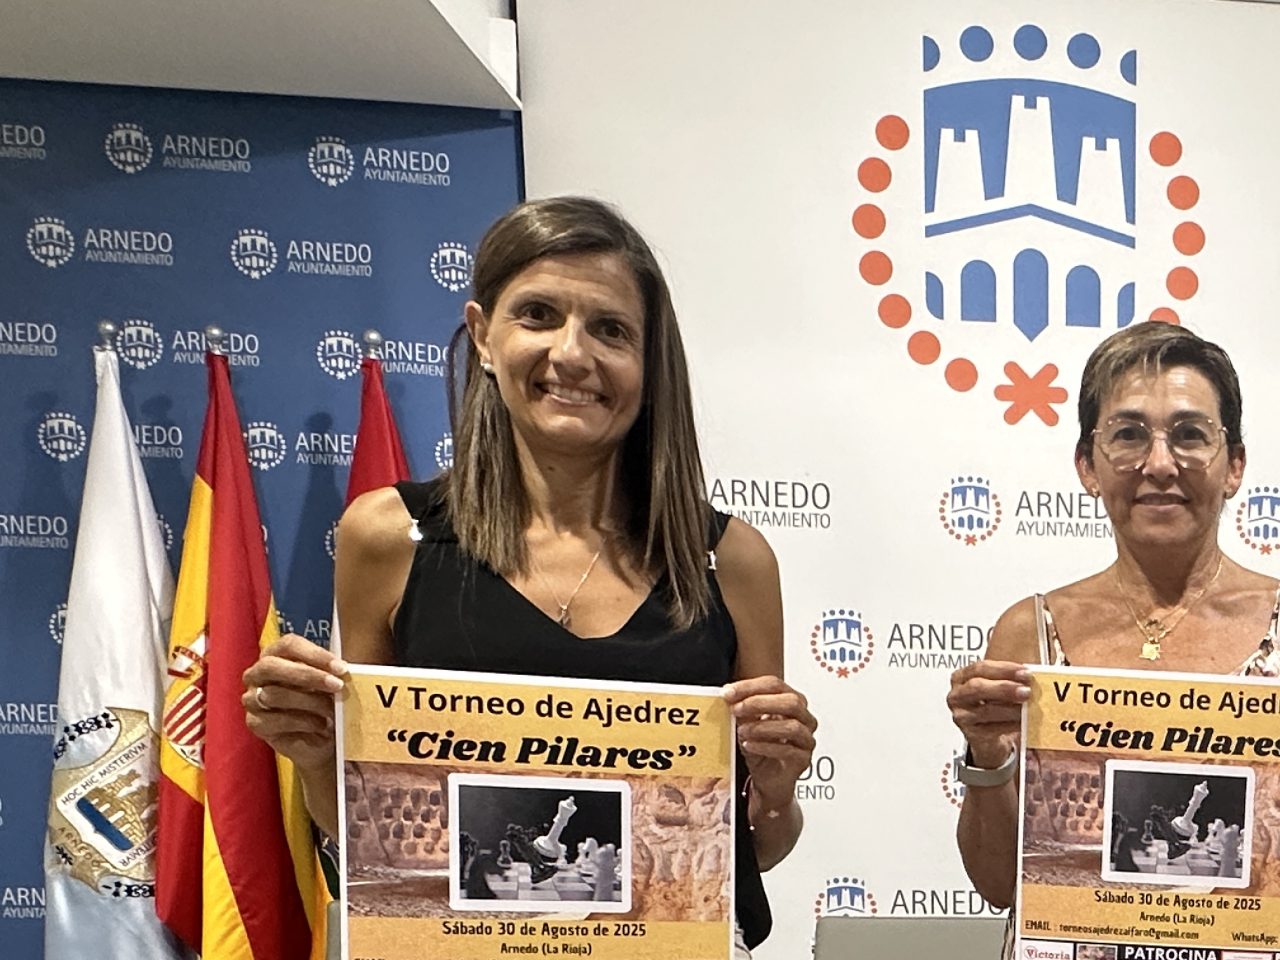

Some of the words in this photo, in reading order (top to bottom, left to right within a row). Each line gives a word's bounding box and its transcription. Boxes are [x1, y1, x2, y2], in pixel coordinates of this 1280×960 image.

[0, 124, 46, 147] EDO
[162, 133, 250, 159] ARNEDO
[162, 156, 251, 173] AYUNTAMIENTO
[363, 146, 450, 173] ARNEDO
[364, 168, 450, 187] AYUNTAMIENTO
[84, 228, 173, 253] ARNEDO
[85, 250, 173, 266] AYUNTAMIENTO
[287, 239, 372, 264] ARNEDO
[288, 260, 373, 277] AYUNTAMIENTO
[0, 321, 57, 344] NEDO
[133, 425, 183, 446] NEDO
[295, 432, 356, 454] ARNE
[709, 478, 831, 510] ARNEDO
[1015, 490, 1108, 520] ARNED
[0, 515, 68, 536] RNEDO
[1016, 520, 1114, 539] AYUNTAMIEN
[375, 685, 399, 709] V
[408, 687, 525, 715] Torneo
[536, 694, 574, 719] de
[583, 698, 700, 728] Ajedrez
[1053, 681, 1071, 702] V
[1078, 683, 1171, 709] Torneo
[1180, 688, 1211, 712] de
[1060, 720, 1154, 750] “Cien
[387, 729, 507, 762] “Cien
[515, 736, 697, 771] Pilares”
[61, 788, 84, 805] HOC
[3, 887, 46, 906] ARN
[1095, 890, 1134, 904] Sábado
[1138, 893, 1153, 905] 30
[1156, 895, 1170, 906] de
[1173, 895, 1213, 910] Agosto
[1216, 897, 1230, 909] de
[1233, 898, 1261, 911] 2025
[1139, 911, 1170, 923] Arnedo
[1173, 913, 1187, 924] (La
[1189, 915, 1215, 926] Rioja)
[442, 920, 492, 935] Sábado
[497, 922, 515, 936] 30
[520, 922, 536, 936] de
[541, 923, 589, 939] Agosto
[593, 923, 609, 936] de
[613, 923, 646, 937] 2025
[500, 943, 539, 954] Arnedo
[542, 942, 558, 956] (La
[561, 943, 592, 956] Rioja)
[1026, 948, 1070, 960] Victoria
